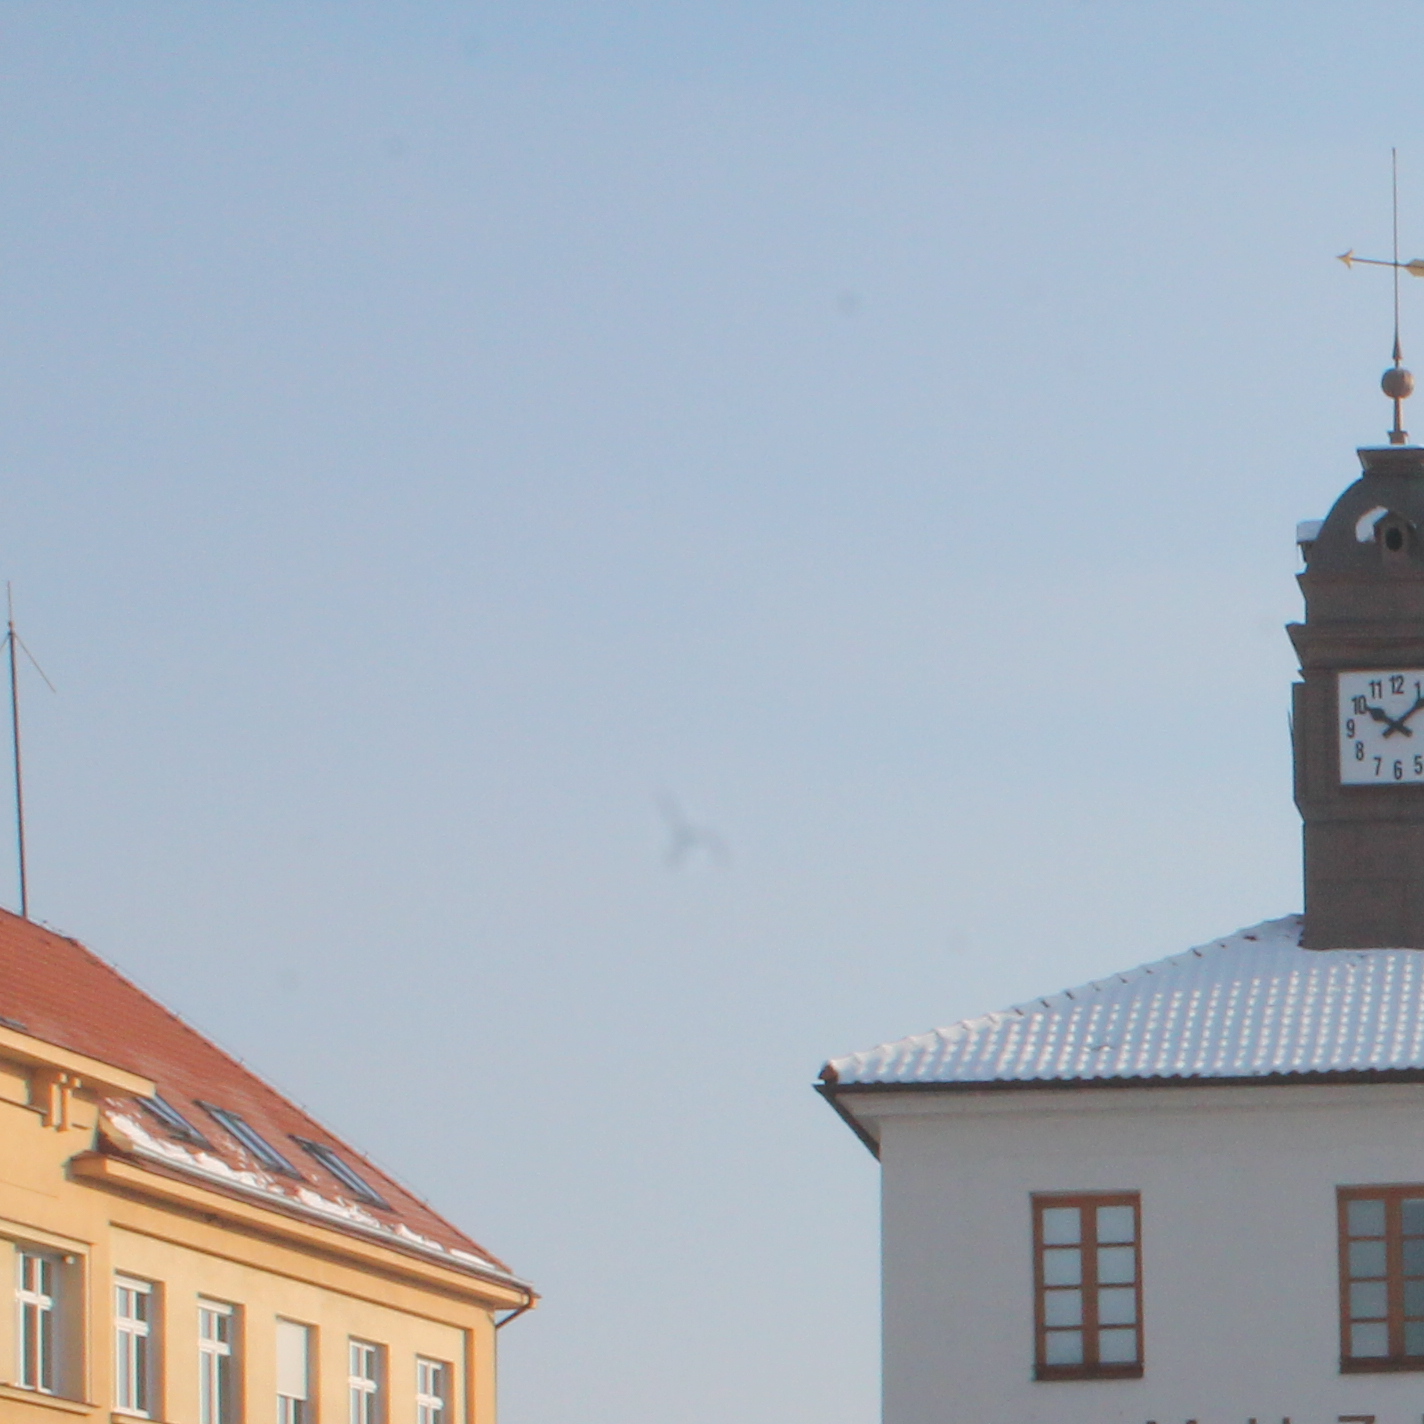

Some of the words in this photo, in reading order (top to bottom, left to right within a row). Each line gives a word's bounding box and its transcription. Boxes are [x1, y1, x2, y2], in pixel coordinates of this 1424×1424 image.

[1369, 680, 1383, 698] 11
[1389, 676, 1405, 694] 12
[1414, 681, 1421, 699] 1
[1352, 695, 1367, 714] 10
[1346, 718, 1355, 738] 9
[1355, 741, 1365, 761] 8
[1373, 757, 1382, 776] 7
[1393, 760, 1403, 780] 6
[1413, 755, 1423, 775] 5
